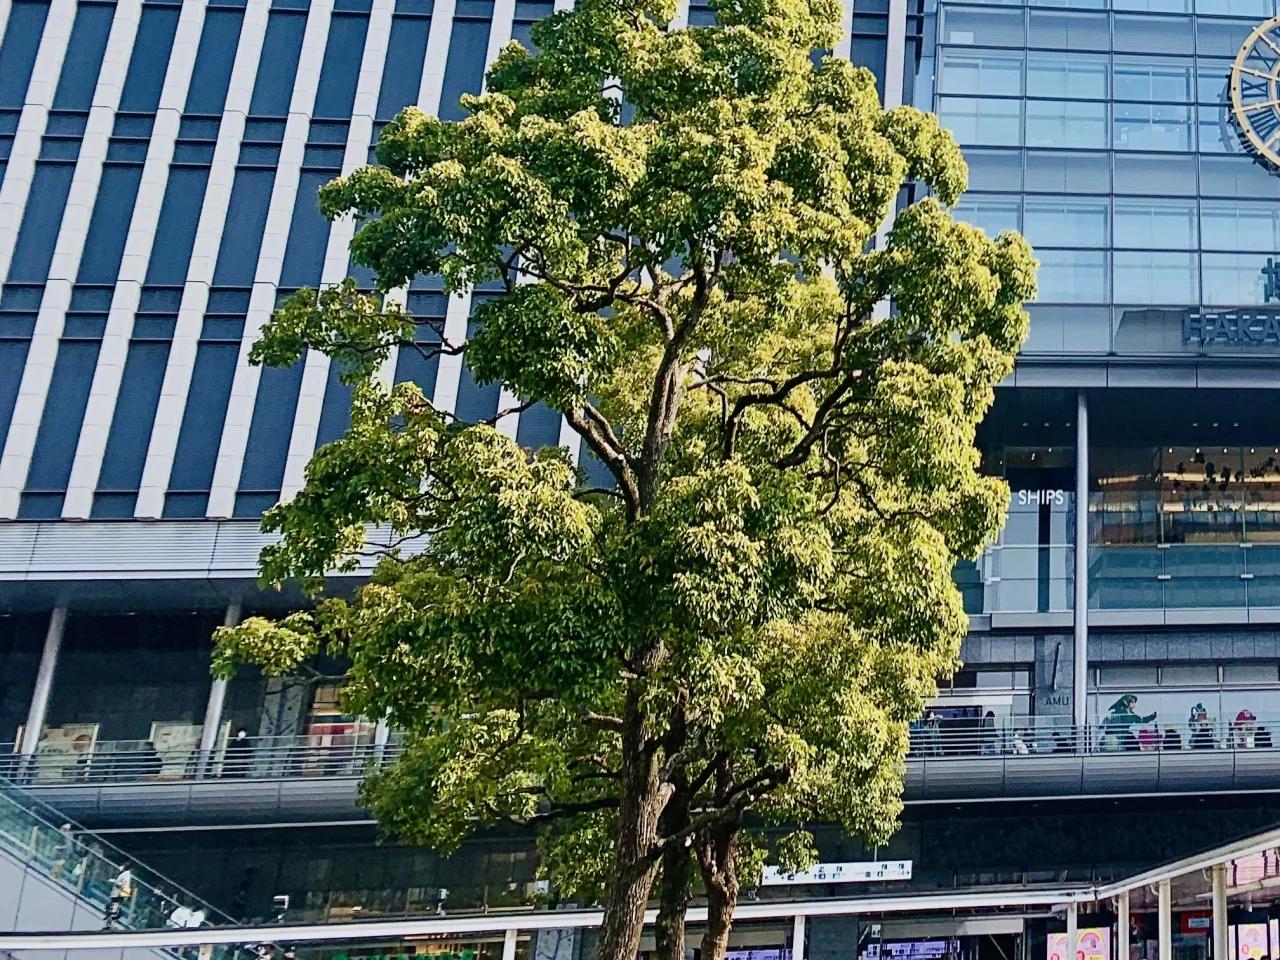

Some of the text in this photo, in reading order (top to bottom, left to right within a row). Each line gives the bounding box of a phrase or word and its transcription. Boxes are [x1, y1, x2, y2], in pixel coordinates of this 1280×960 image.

[1247, 45, 1278, 71] X
[1240, 78, 1269, 100] IX
[1018, 489, 1064, 506] SHIPS
[1045, 695, 1069, 706] AMU
